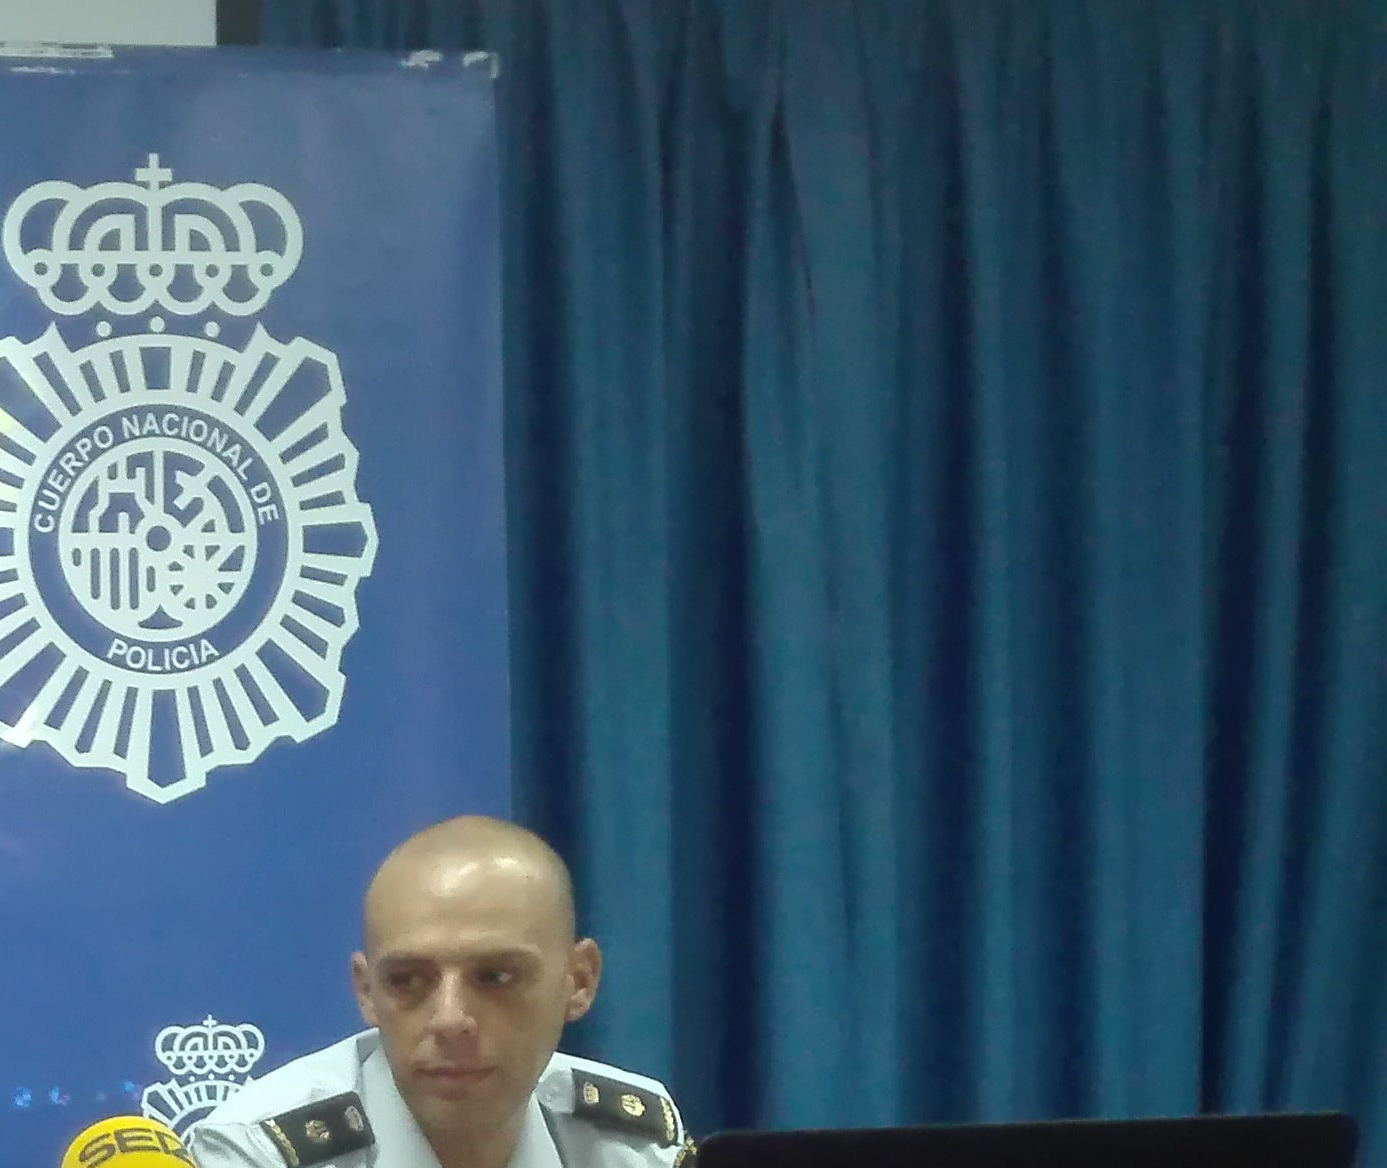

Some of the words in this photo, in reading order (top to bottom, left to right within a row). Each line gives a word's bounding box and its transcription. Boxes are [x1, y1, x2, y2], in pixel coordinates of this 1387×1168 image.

[33, 425, 114, 534] CUERPO
[121, 412, 254, 482] NACIONAL
[250, 481, 280, 525] DE
[107, 637, 220, 671] POLICIA
